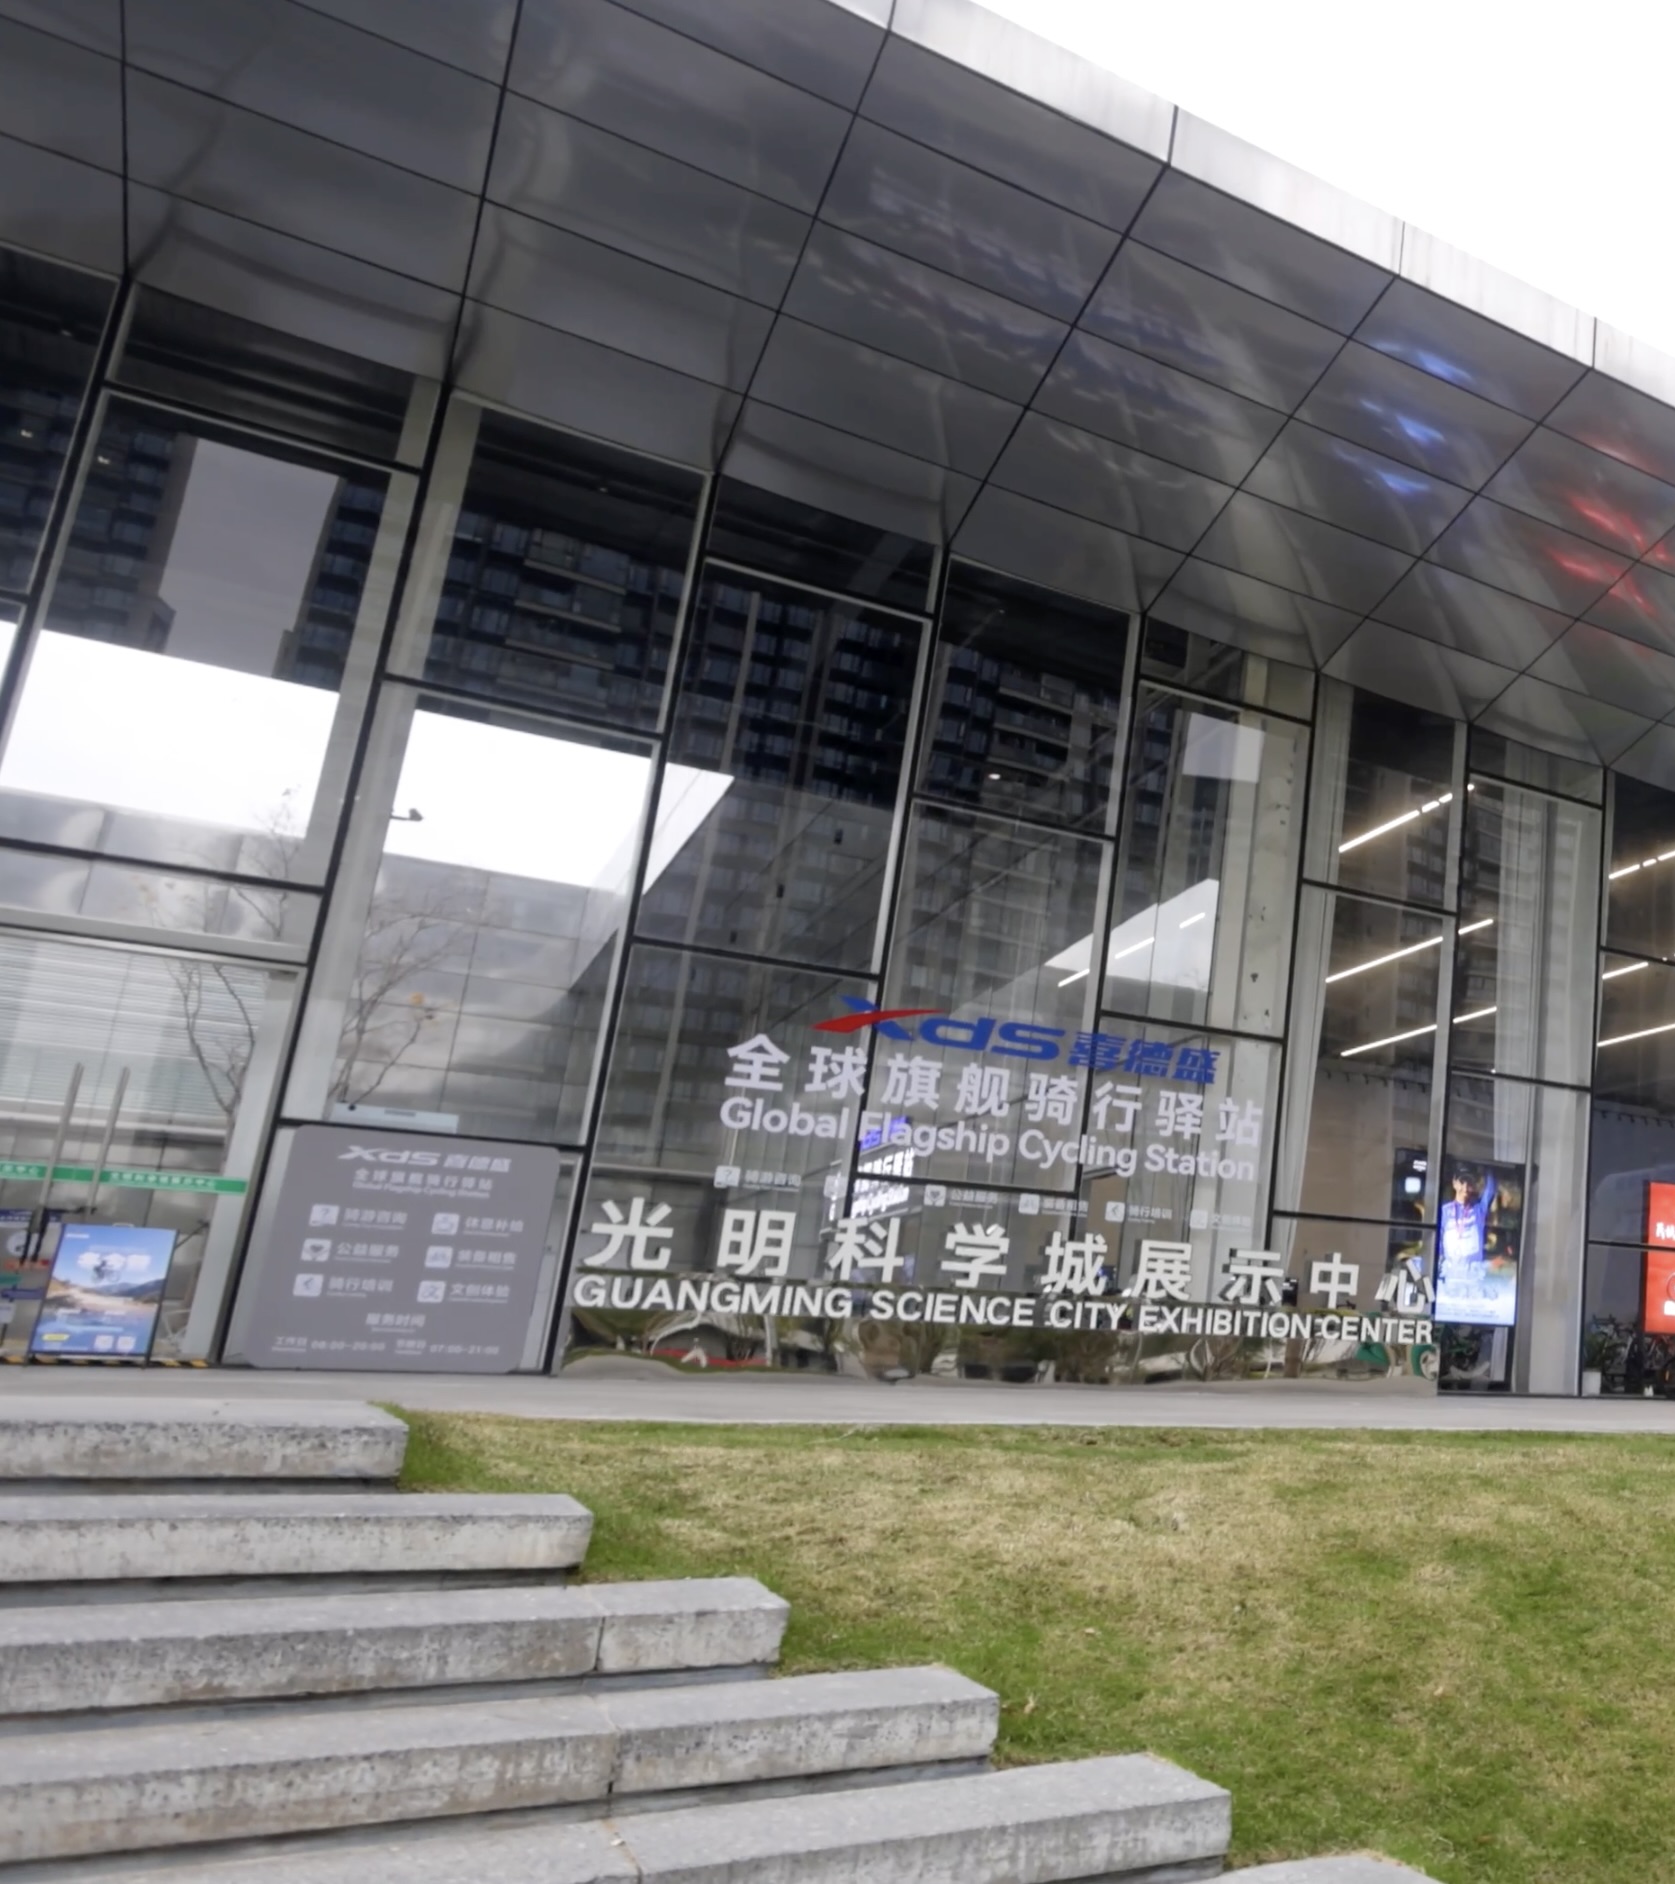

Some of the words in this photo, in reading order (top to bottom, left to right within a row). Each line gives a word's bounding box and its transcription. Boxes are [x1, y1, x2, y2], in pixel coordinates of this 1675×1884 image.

[723, 1032, 1264, 1149] 全球旗舰骑行驿站
[1067, 1032, 1221, 1085] 喜德盛
[720, 1096, 850, 1140] Global
[858, 1109, 1016, 1168] Flagship
[1019, 1130, 1138, 1179] Cycling
[1145, 1144, 1255, 1182] Station
[584, 1197, 1435, 1315] 光明科学城展示中心
[574, 1274, 852, 1319] GUANGMING
[869, 1289, 1036, 1327] SCIENCE
[1049, 1299, 1125, 1331] CITY
[1138, 1305, 1313, 1338] EXHIBITION
[1320, 1316, 1434, 1344] CENTER
